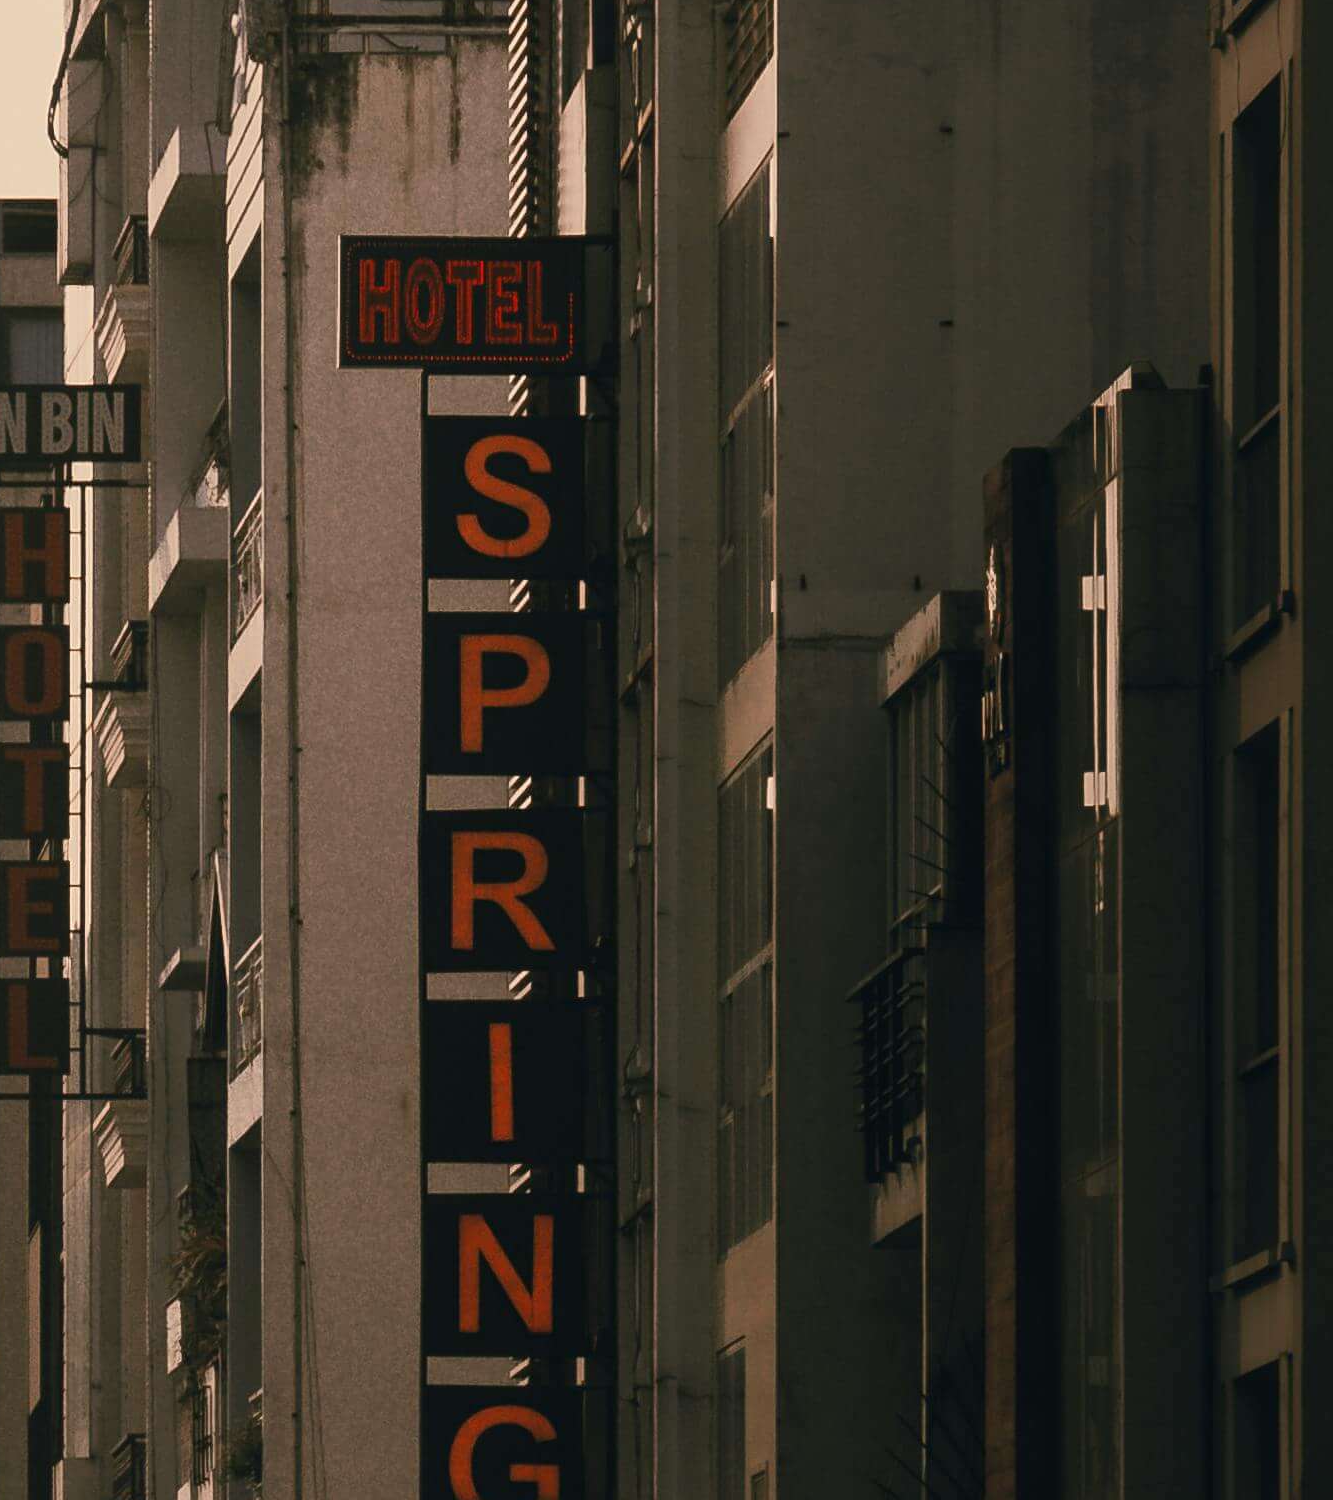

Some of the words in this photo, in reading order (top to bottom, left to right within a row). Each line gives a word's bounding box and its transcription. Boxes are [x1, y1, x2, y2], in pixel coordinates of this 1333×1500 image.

[356, 257, 560, 347] HOTEL
[39, 391, 126, 455] BIN
[2, 507, 68, 1070] HOTEL
